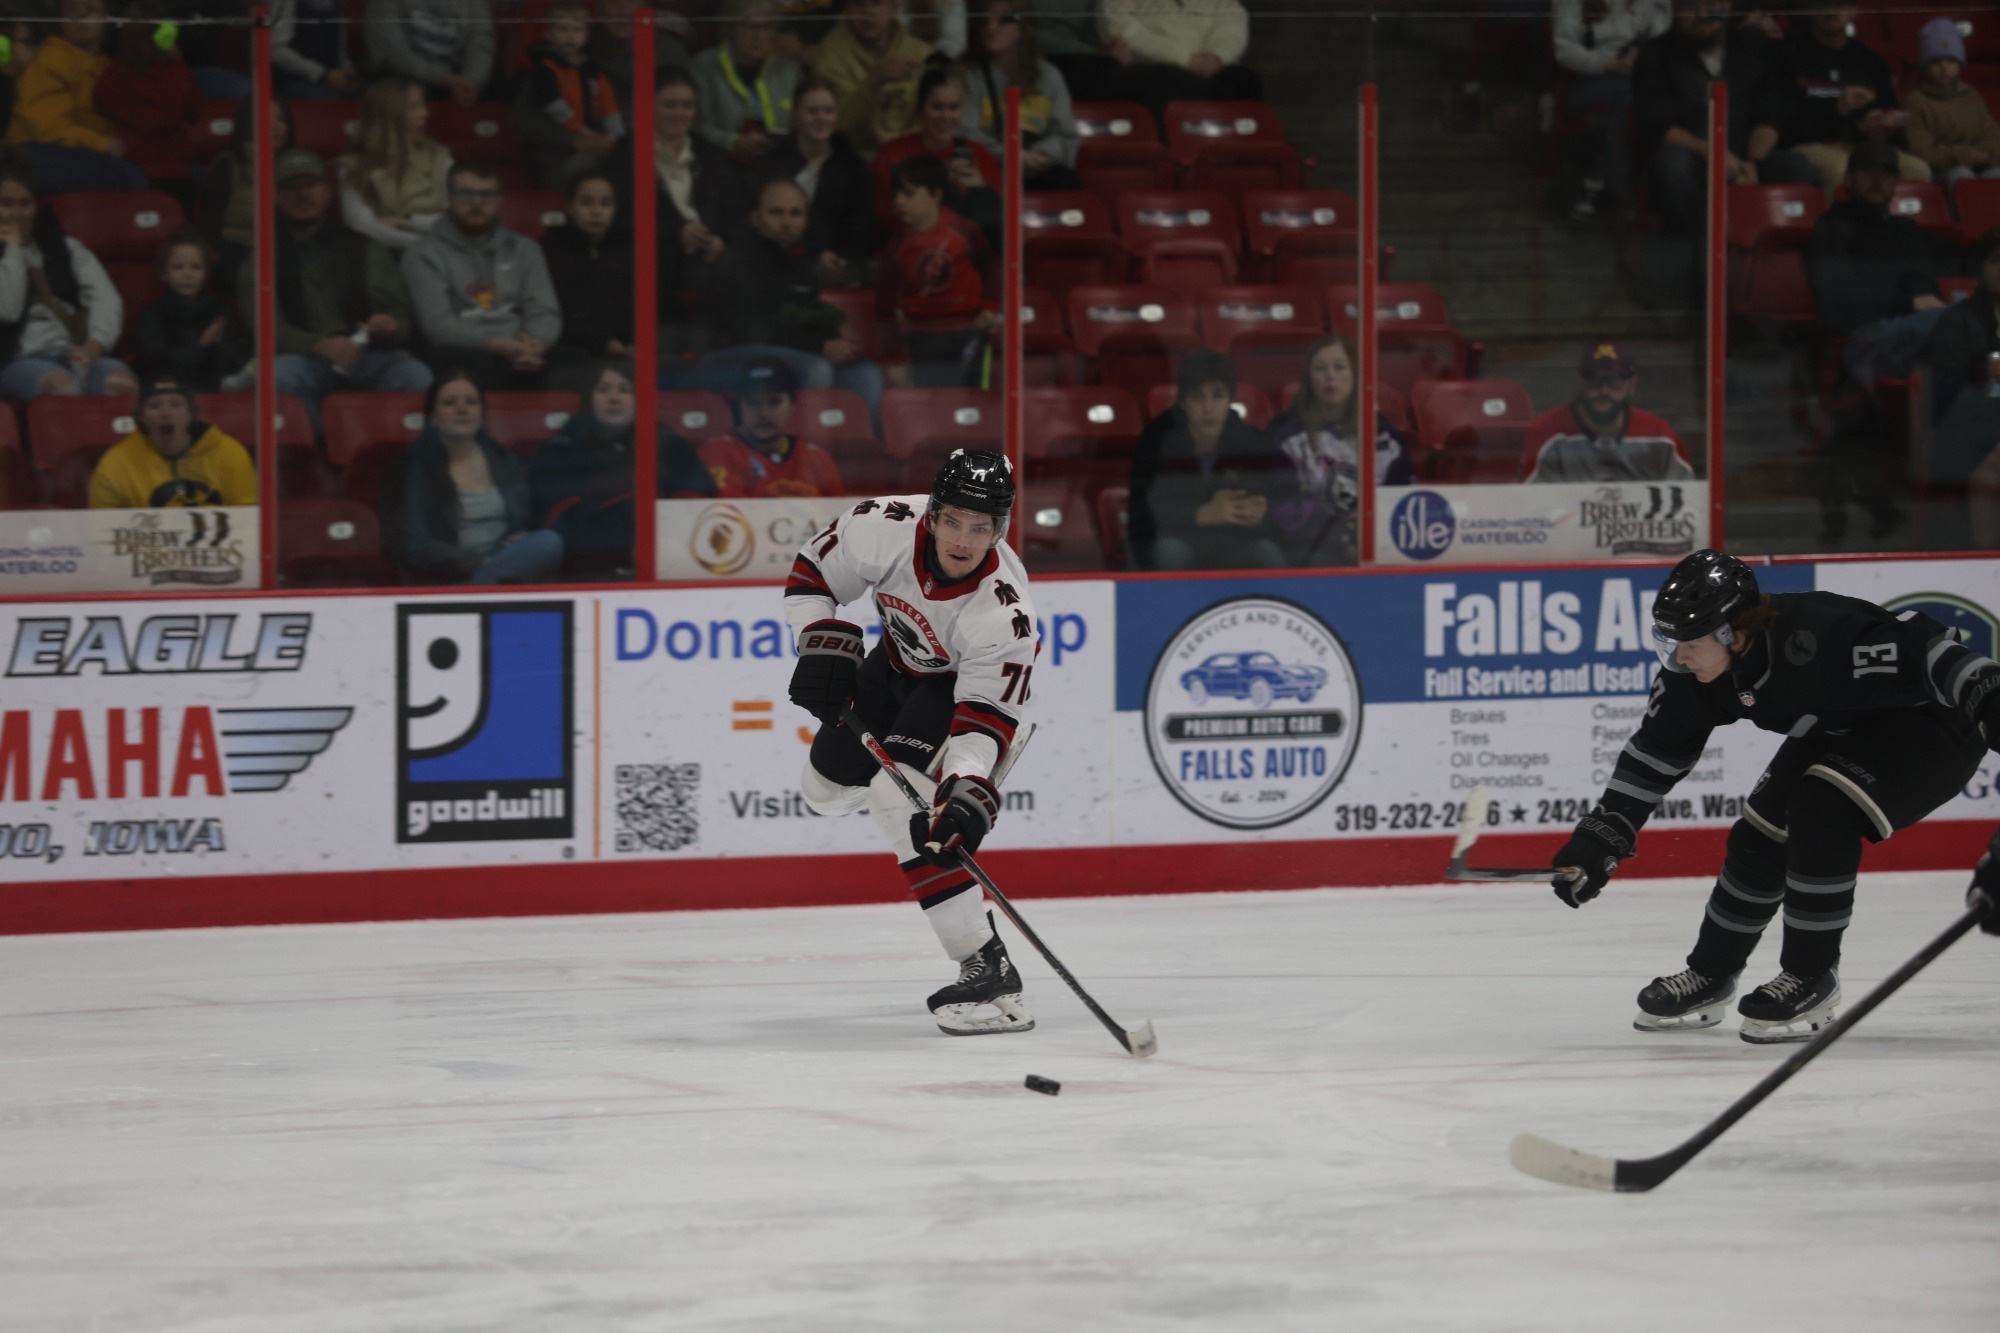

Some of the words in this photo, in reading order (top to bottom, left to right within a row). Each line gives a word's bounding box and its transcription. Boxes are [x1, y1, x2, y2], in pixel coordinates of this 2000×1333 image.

[1580, 500, 1641, 528] BREW
[1245, 612, 1280, 626] AND
[1424, 578, 1583, 658] Falls
[4, 612, 312, 678] EAGLE
[1852, 641, 1899, 679] 13
[1425, 666, 1464, 698] Full
[1466, 664, 1547, 697] Service
[1550, 663, 1591, 694] and
[1593, 661, 1647, 693] Used
[1183, 718, 1249, 737] PREMIUM
[1450, 708, 1507, 724] Brakes
[1450, 729, 1491, 746] Tires
[1181, 748, 1255, 781] FALLS
[1265, 746, 1327, 778] AUTO
[1450, 752, 1473, 768] Oil
[1477, 751, 1550, 770] Changes
[407, 788, 565, 837] goodwill
[728, 789, 805, 819] Visit
[1336, 800, 1500, 832] 319-232-246
[83, 817, 226, 856] IOWA
